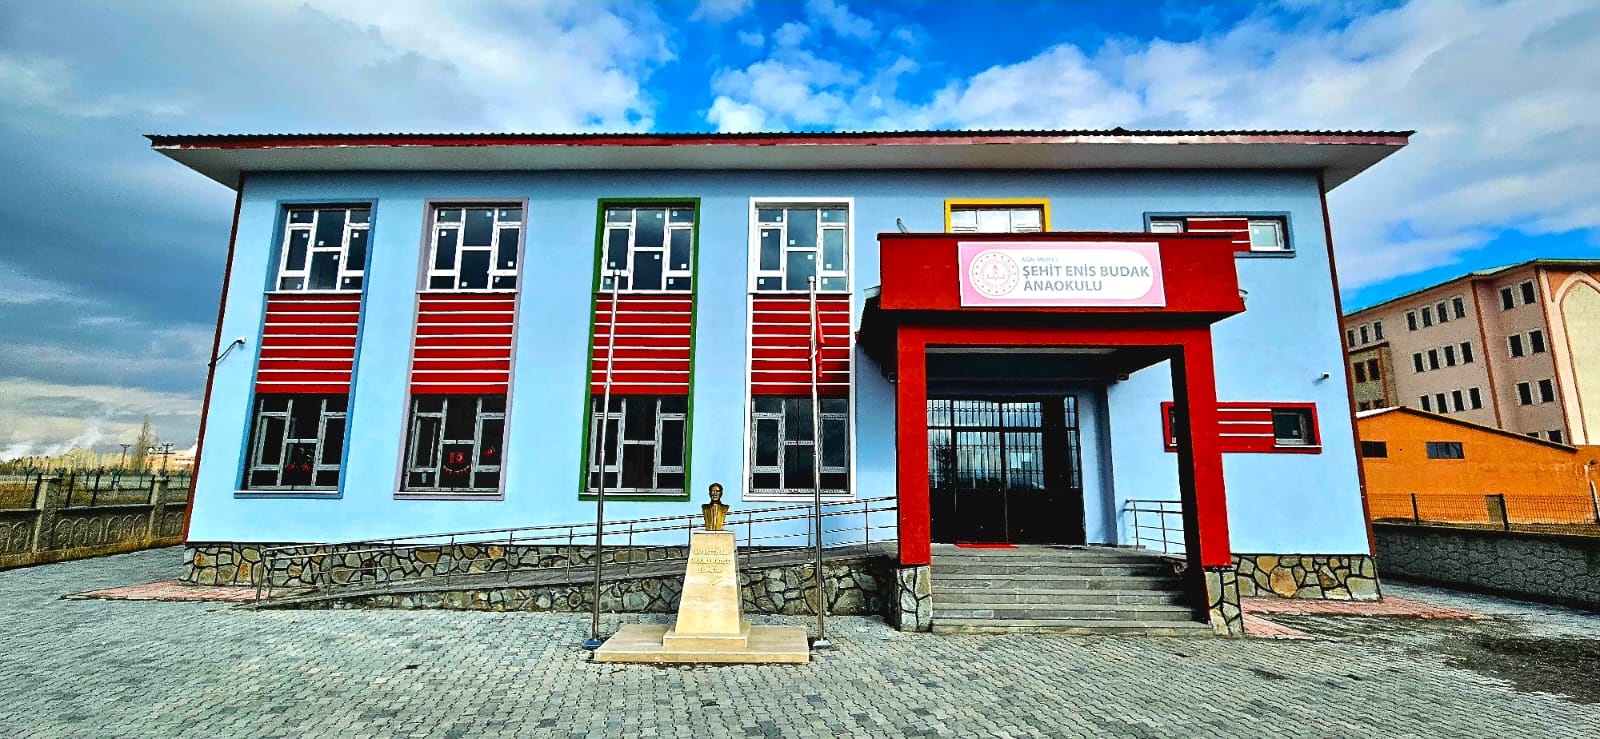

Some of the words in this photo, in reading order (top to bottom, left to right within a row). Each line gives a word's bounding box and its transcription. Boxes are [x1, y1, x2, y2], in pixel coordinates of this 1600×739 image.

[1022, 264, 1062, 279] ŞEHİT
[1065, 264, 1097, 277] ENİS
[1100, 266, 1150, 277] BUDAK
[1023, 280, 1103, 292] ANAOKULU
